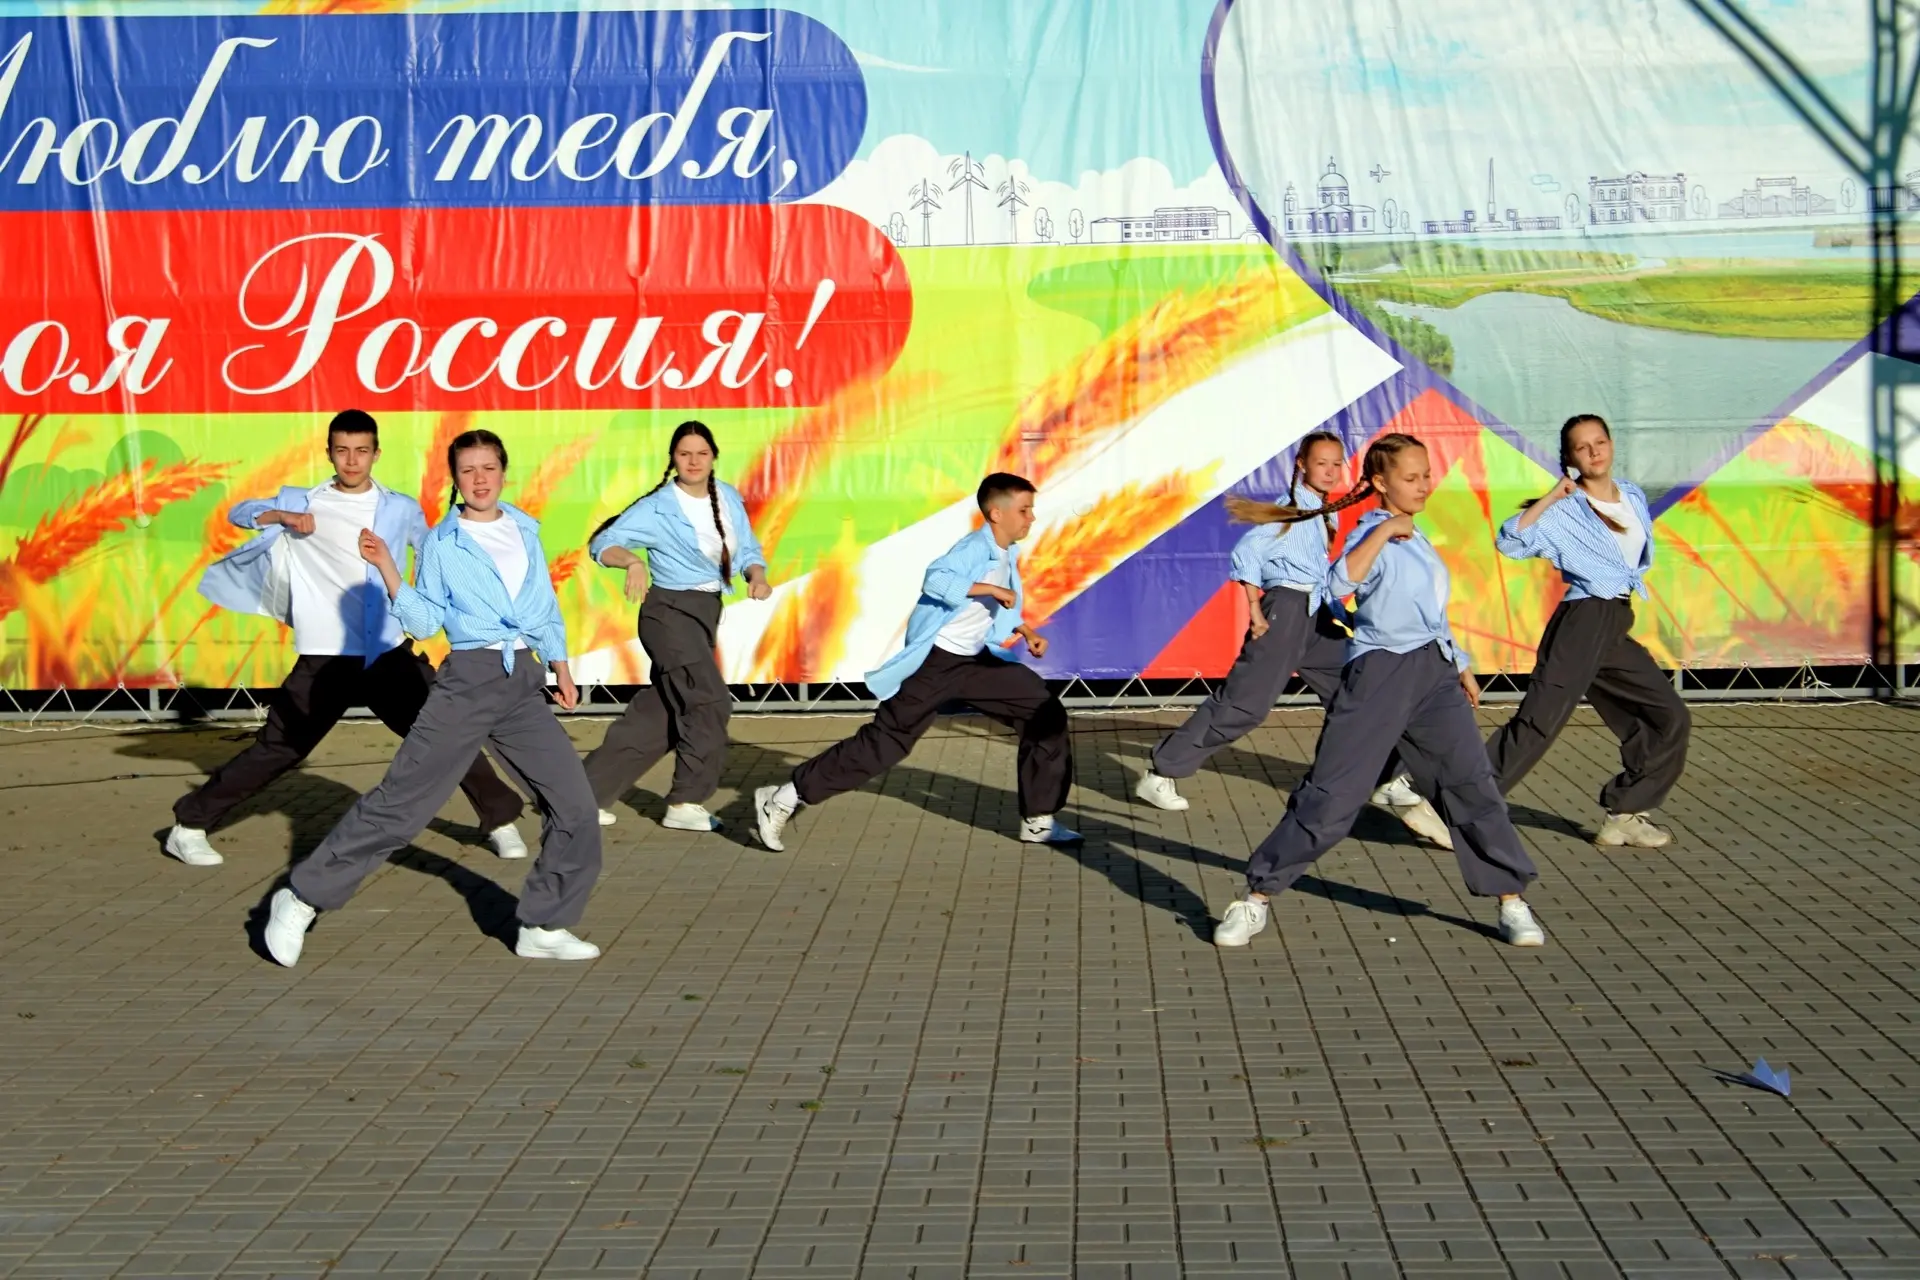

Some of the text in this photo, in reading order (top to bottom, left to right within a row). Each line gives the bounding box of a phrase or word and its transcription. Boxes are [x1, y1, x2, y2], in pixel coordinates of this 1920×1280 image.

[426, 31, 798, 202] тебя,
[0, 232, 836, 396] оя Россия!
